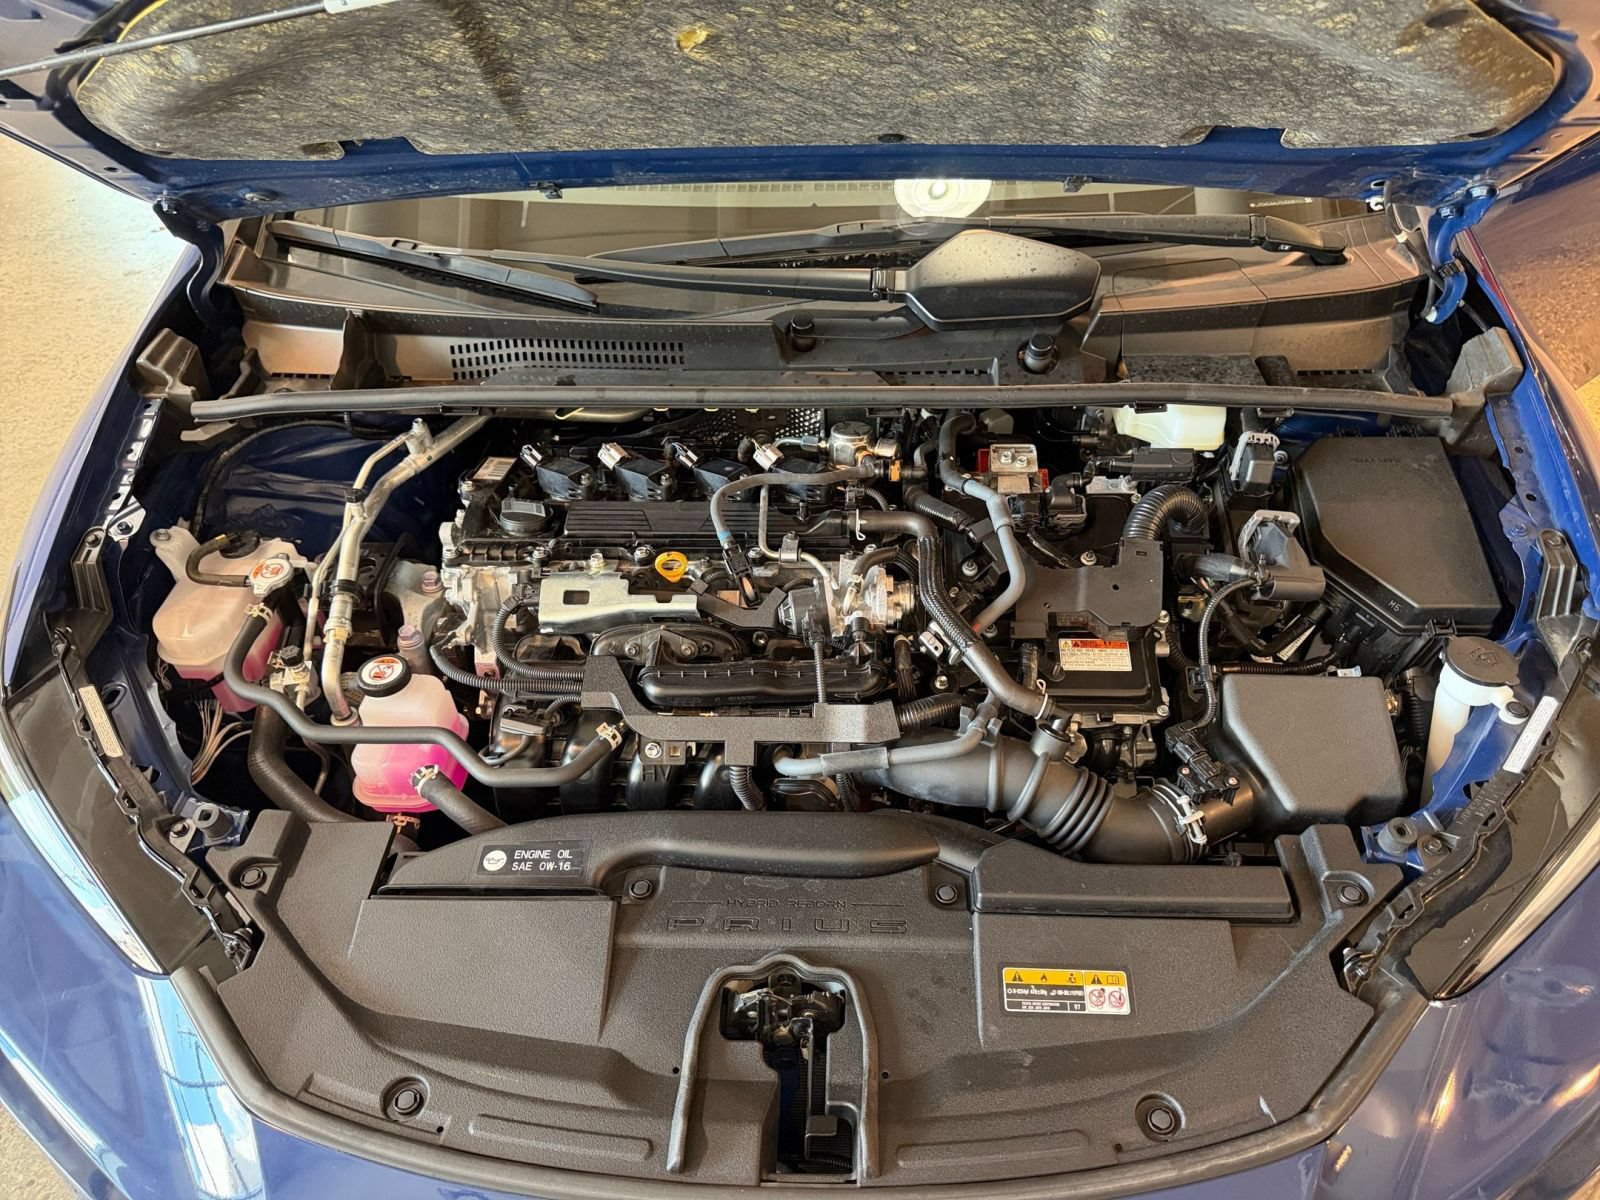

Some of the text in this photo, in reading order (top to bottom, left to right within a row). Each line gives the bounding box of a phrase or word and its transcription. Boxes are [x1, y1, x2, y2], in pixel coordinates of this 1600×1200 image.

[514, 849, 573, 859] ENGINE OIL
[511, 861, 571, 871] SAE 0W-16
[726, 900, 847, 909] HYBRID REBORN
[667, 917, 907, 934] PRIUS
